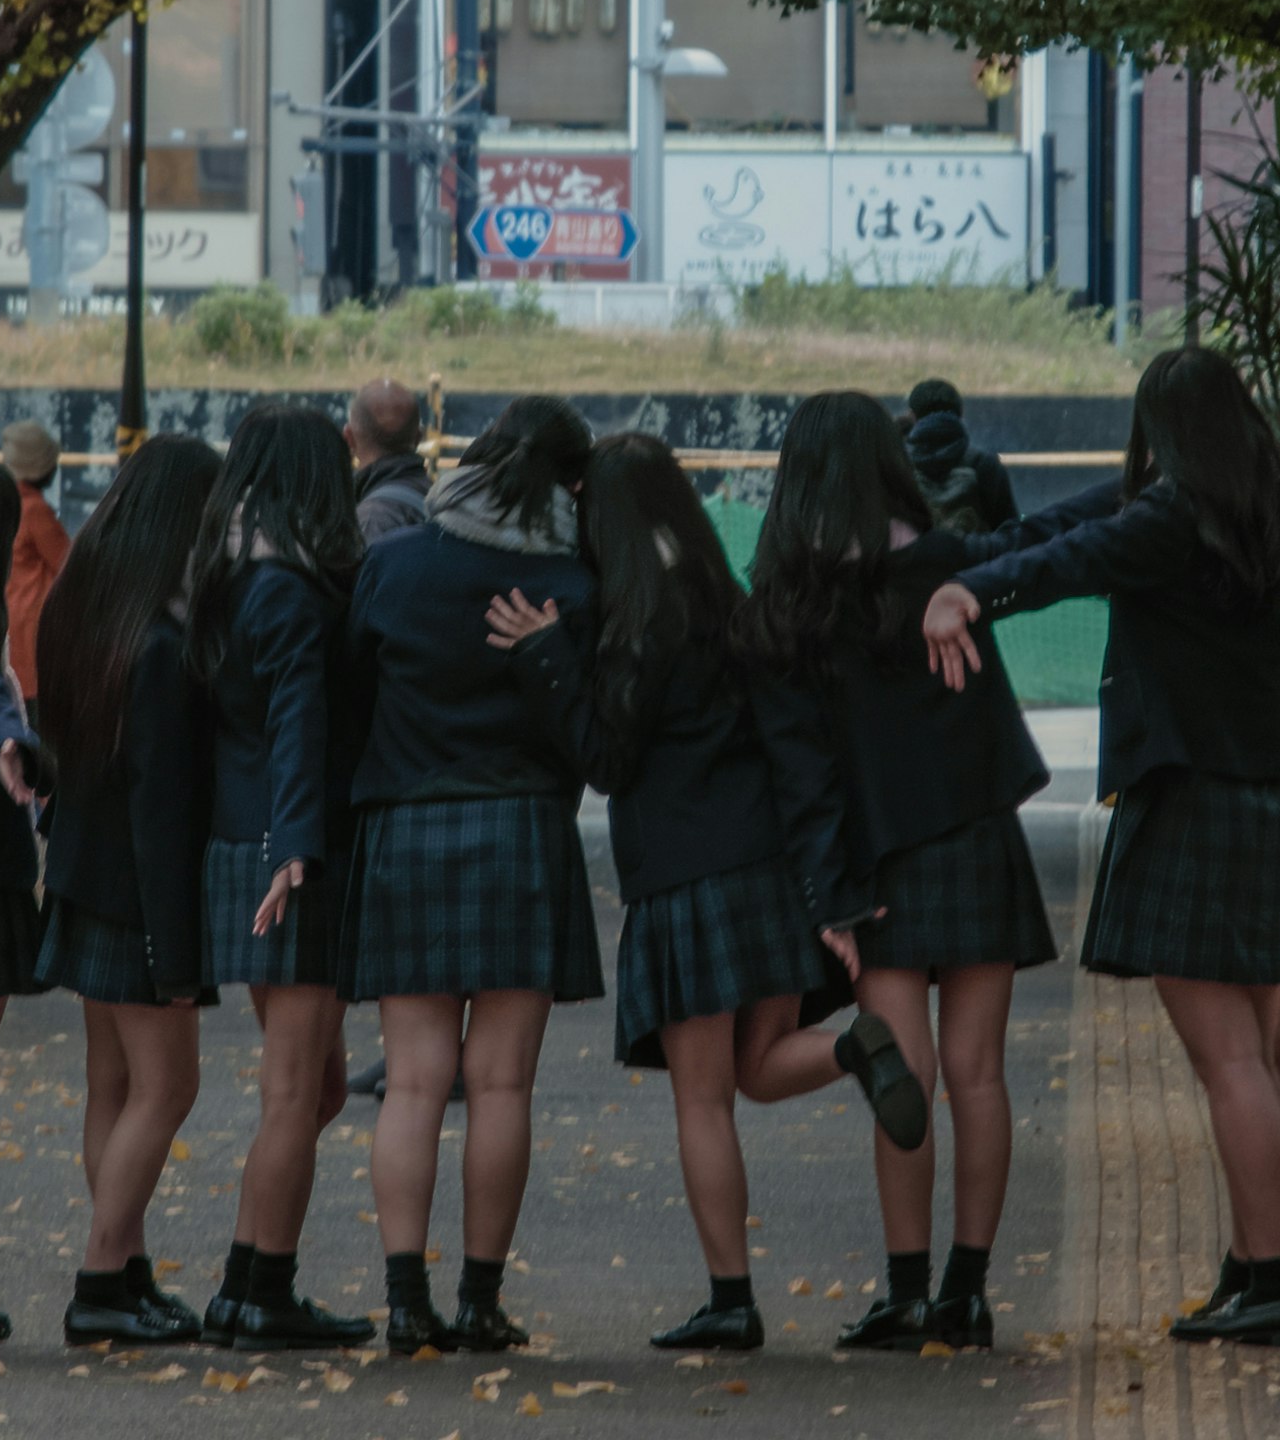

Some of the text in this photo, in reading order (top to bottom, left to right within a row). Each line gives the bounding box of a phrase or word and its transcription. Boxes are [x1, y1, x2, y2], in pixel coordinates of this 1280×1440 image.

[502, 212, 547, 241] 246
[856, 195, 1011, 244] はら八
